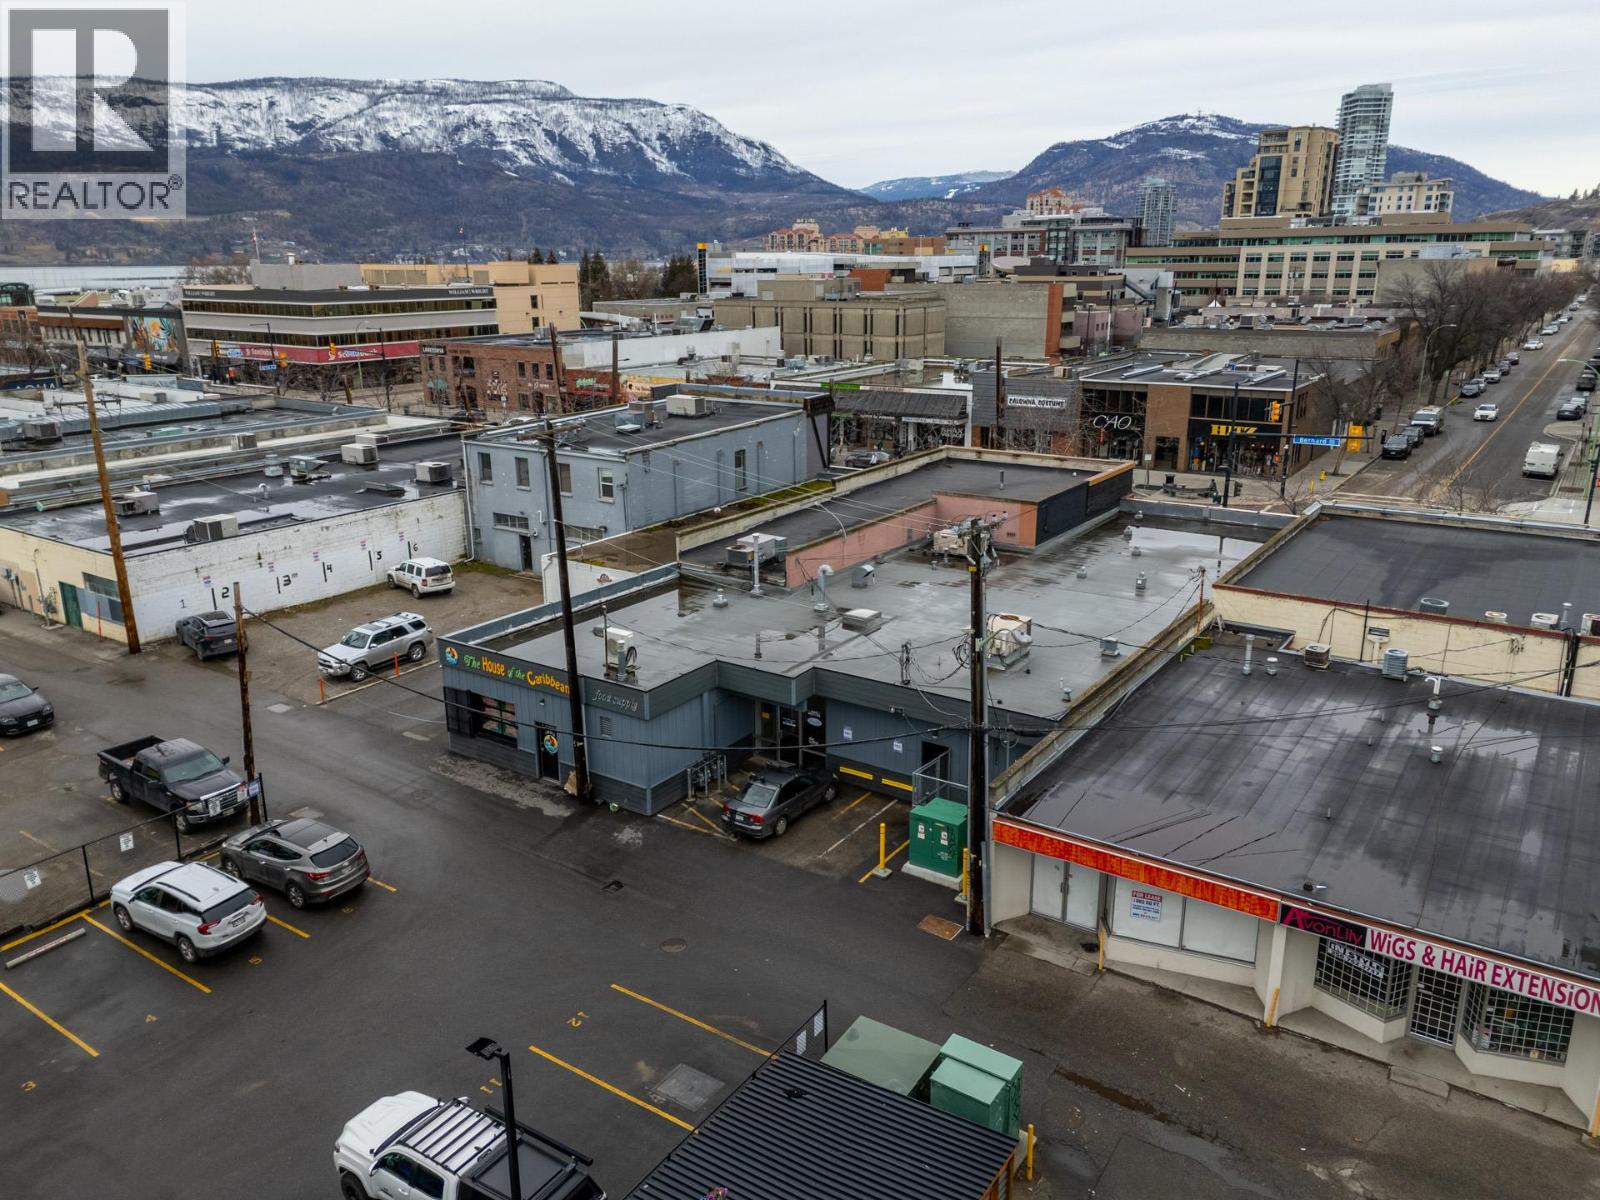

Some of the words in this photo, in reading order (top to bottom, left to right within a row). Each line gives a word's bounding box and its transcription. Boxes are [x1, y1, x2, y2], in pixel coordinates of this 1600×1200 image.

[412, 543, 419, 552] 6
[376, 550, 382, 560] 5
[326, 564, 333, 573] 4
[282, 574, 292, 587] 3
[221, 586, 230, 598] 2
[180, 599, 187, 609] 1
[463, 654, 481, 670] The
[481, 656, 506, 676] House
[507, 666, 515, 678] of
[515, 669, 525, 681] the
[527, 671, 570, 694] Caribbean
[1144, 892, 1161, 902] LEASE
[1370, 928, 1417, 962] WiGS
[1422, 945, 1436, 967] &
[1440, 950, 1487, 982] HAiR
